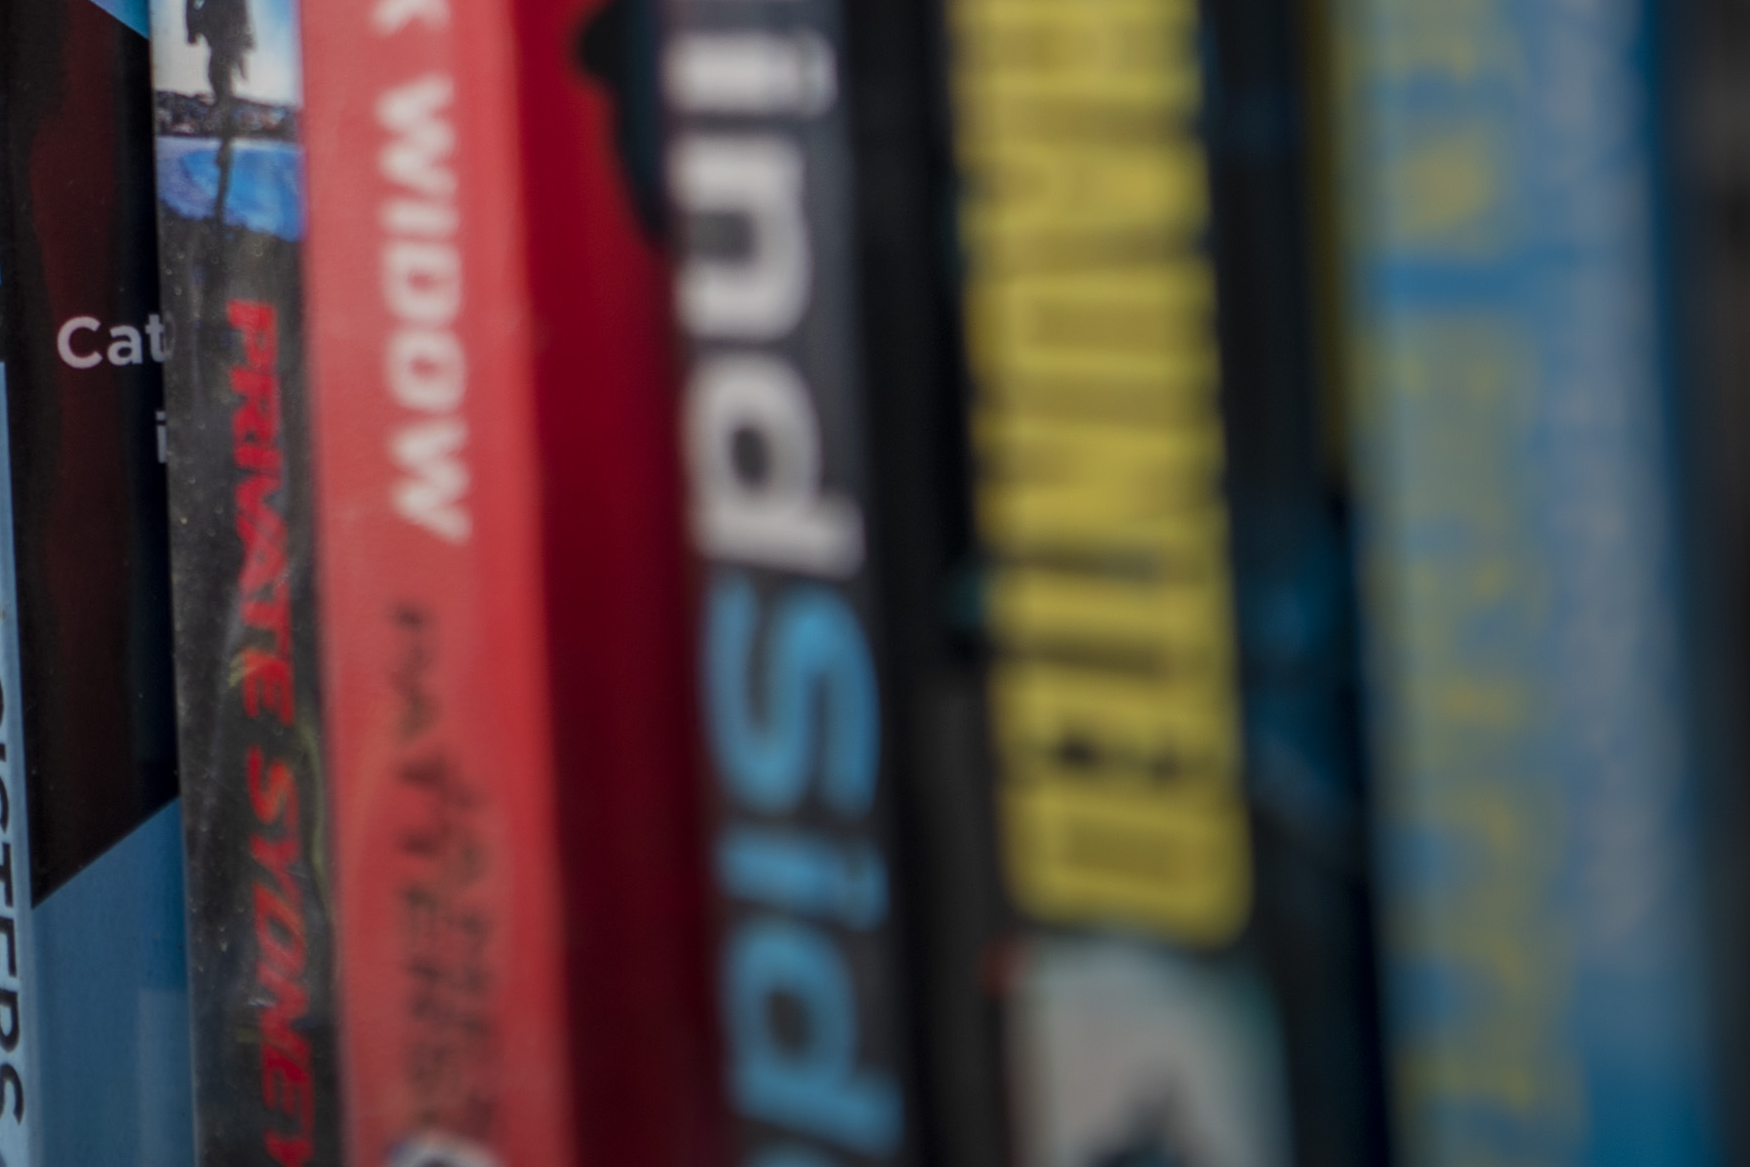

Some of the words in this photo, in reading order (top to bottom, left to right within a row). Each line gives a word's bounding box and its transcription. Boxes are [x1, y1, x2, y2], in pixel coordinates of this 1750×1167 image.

[57, 313, 167, 370] Cat
[226, 297, 295, 727] PRIVATE
[375, 73, 473, 547] WIDOW
[247, 743, 316, 1167] SYDNEY
[388, 599, 458, 1138] PATTERS
